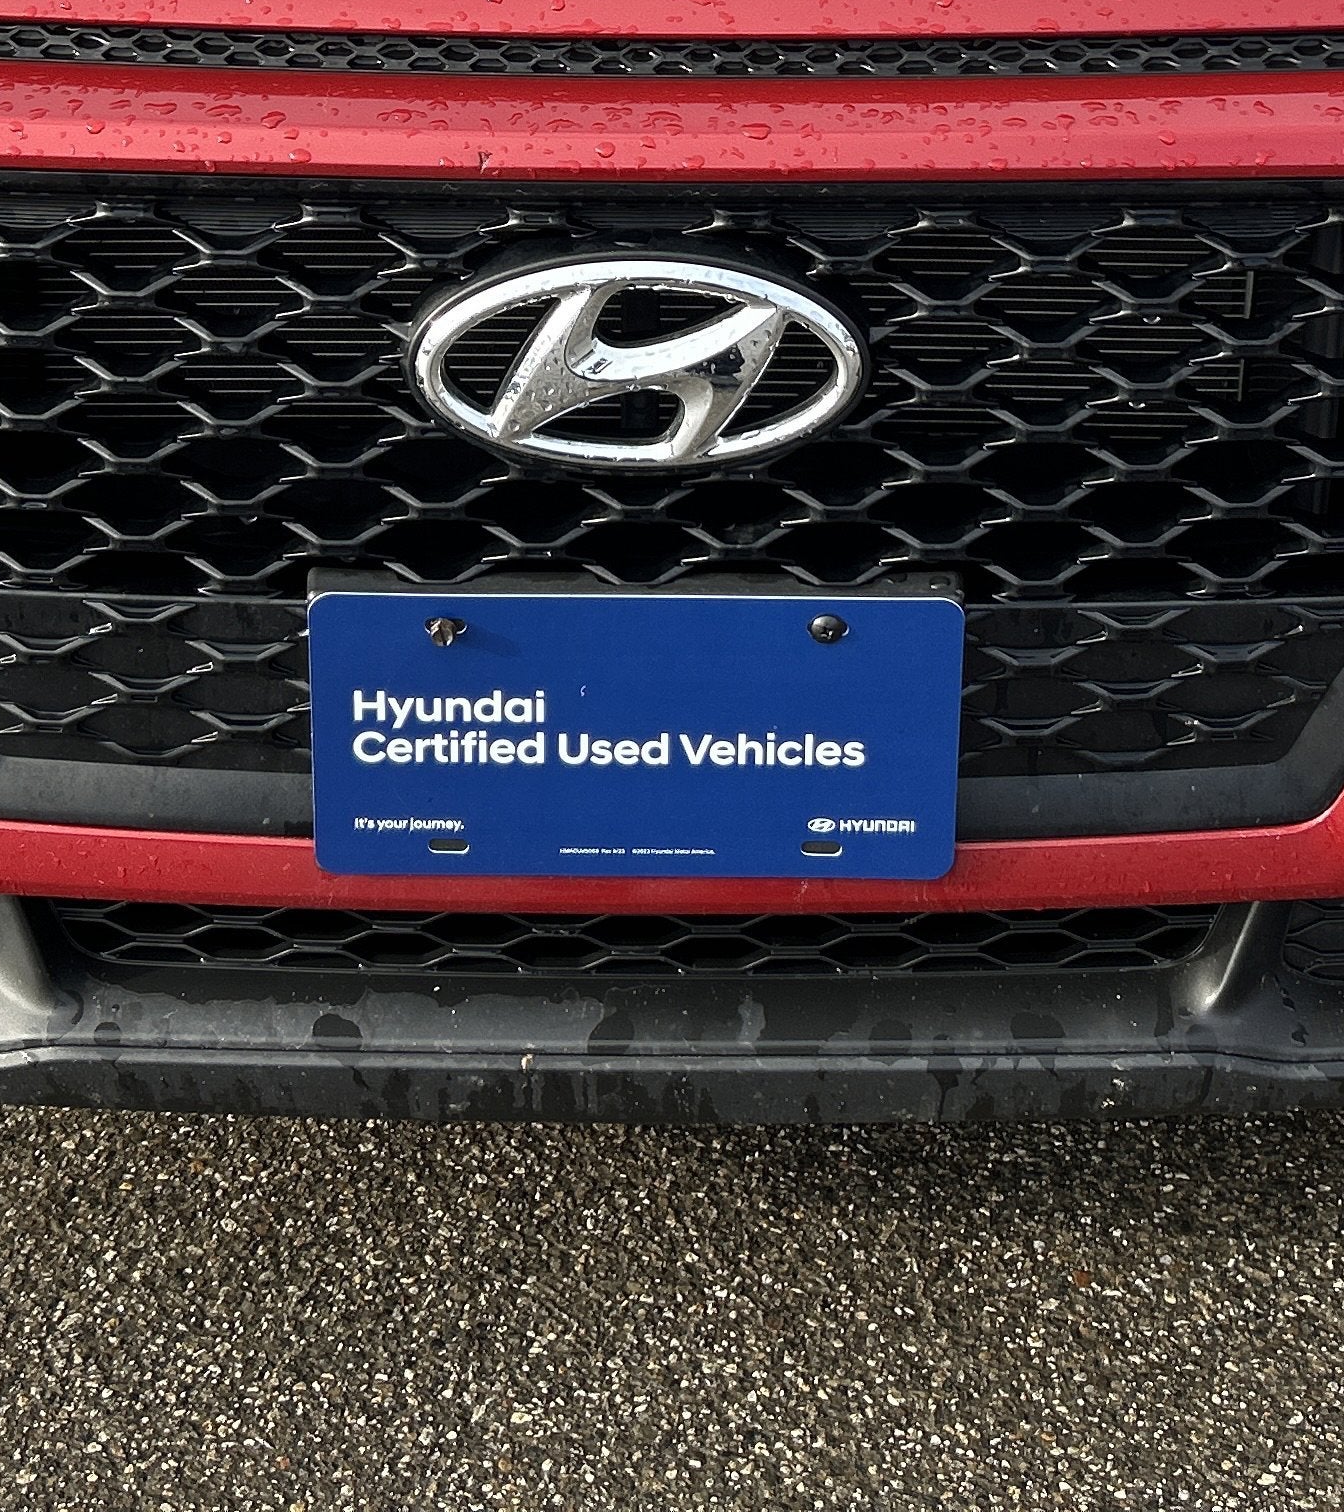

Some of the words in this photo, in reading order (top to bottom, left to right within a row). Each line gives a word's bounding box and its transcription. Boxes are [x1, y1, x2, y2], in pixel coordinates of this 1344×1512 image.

[353, 689, 545, 729] Hyundai
[352, 730, 545, 764] Certified
[558, 732, 669, 766] Used
[679, 733, 865, 767] Vehicles
[376, 819, 408, 833] your
[409, 817, 465, 834] journey.
[839, 819, 915, 833] HYUNDAI
